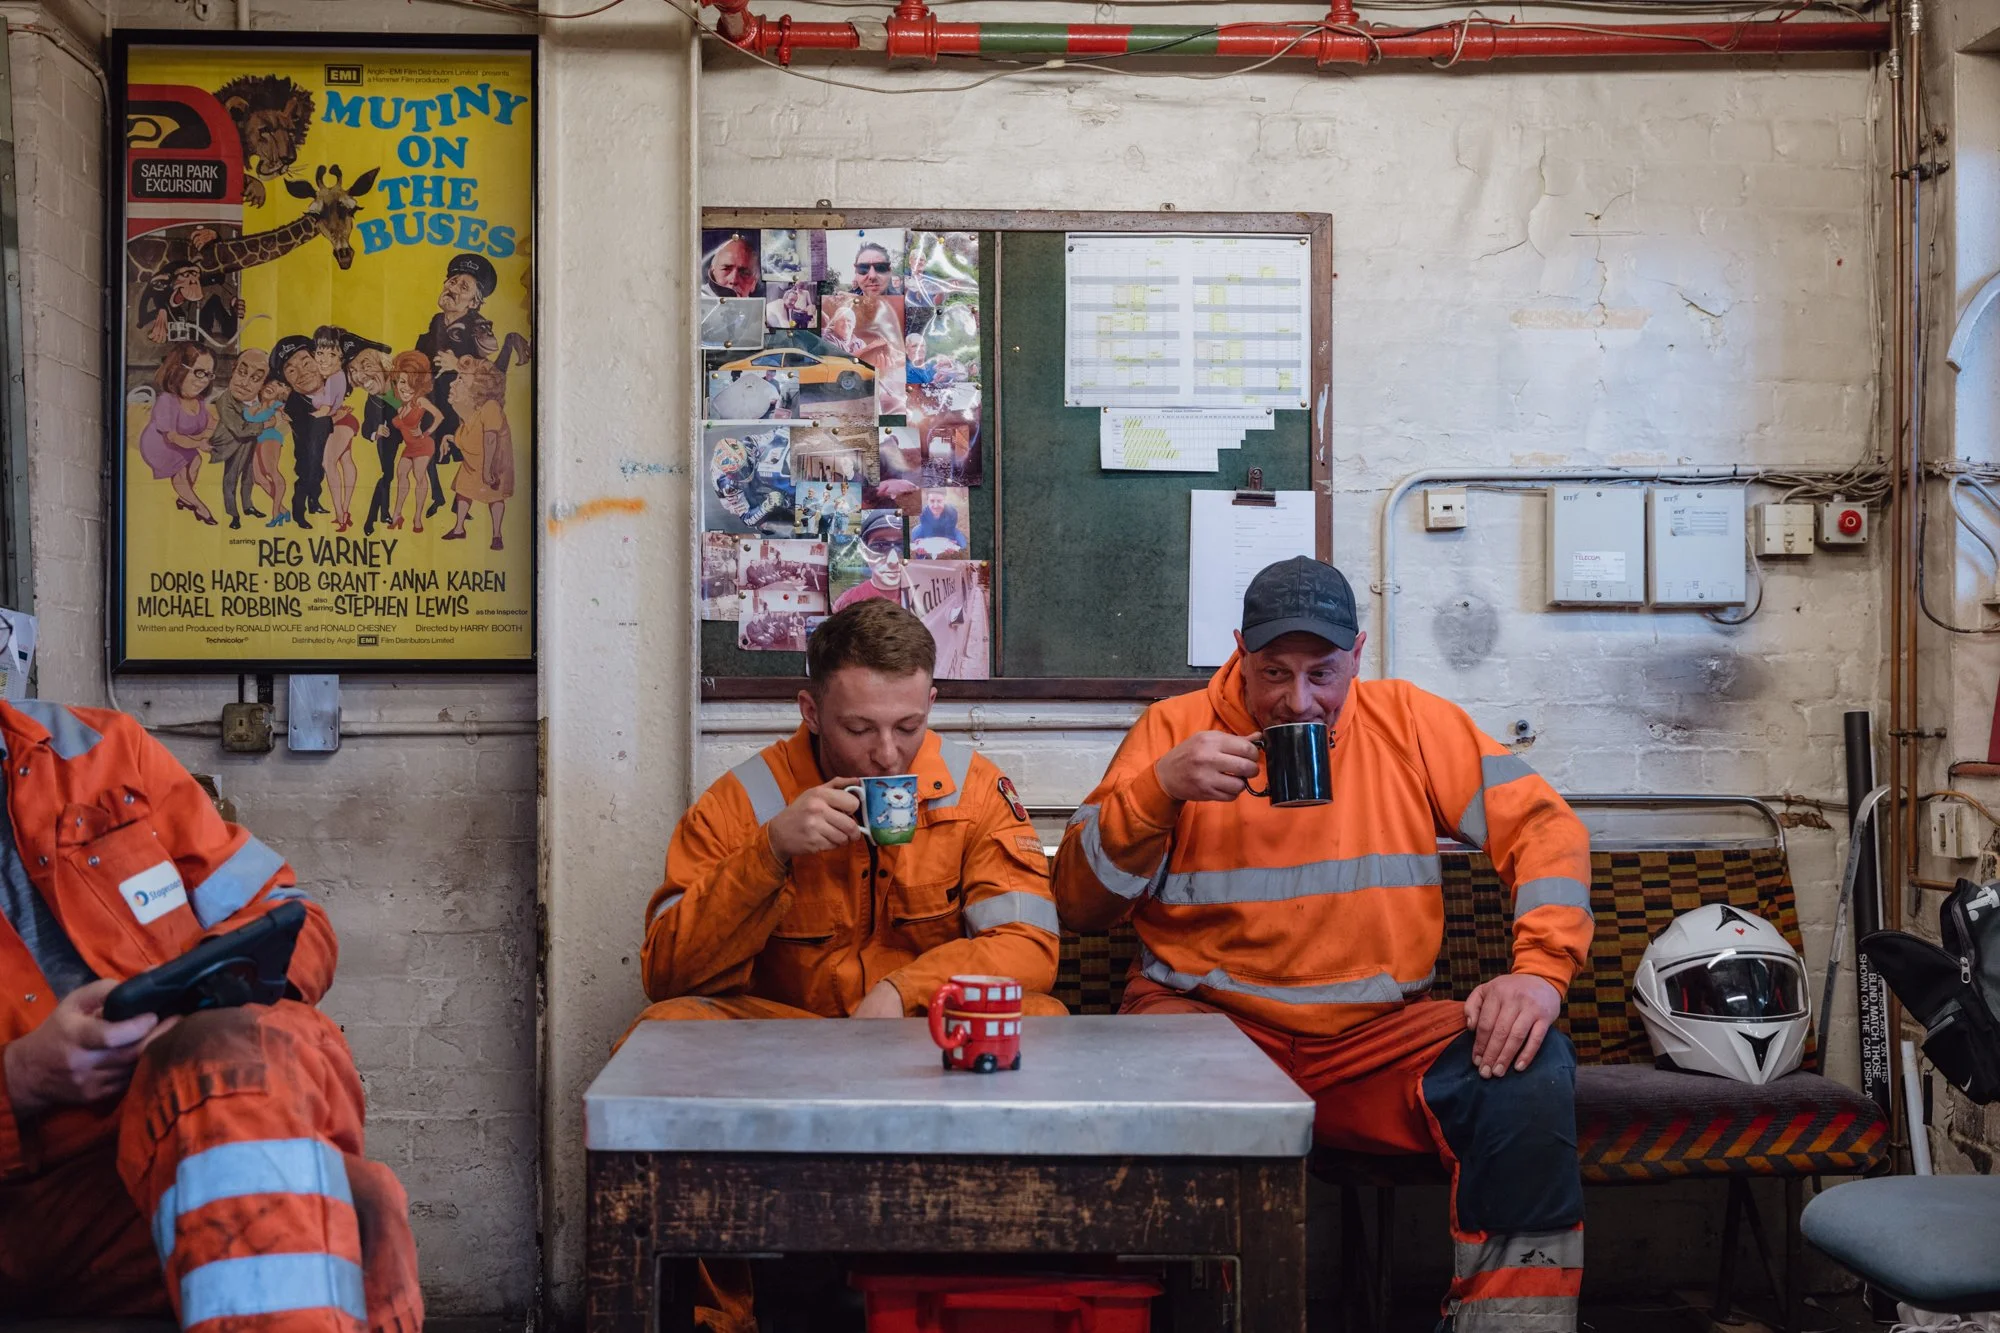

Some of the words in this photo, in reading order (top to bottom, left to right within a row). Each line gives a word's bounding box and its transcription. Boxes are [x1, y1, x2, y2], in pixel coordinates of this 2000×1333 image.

[330, 69, 358, 81] EMI
[321, 83, 529, 133] MUTINY
[398, 135, 469, 169] ON
[141, 164, 183, 178] SAFARI
[187, 165, 218, 179] PARK
[146, 179, 212, 193] EXCURSION
[378, 175, 479, 212] THE
[357, 212, 516, 259] BUSES
[229, 538, 256, 546] starring
[258, 537, 304, 568] REG
[308, 536, 398, 568] VARNEY
[151, 571, 206, 594] DORIS
[212, 570, 259, 593] HARE
[274, 571, 311, 592] BOB
[318, 571, 380, 593] GRANT
[390, 569, 439, 593] ANNA
[448, 570, 506, 592] KAREN
[138, 595, 214, 618] MICHAEL
[222, 595, 303, 618] ROBBINS
[308, 605, 333, 613] starring
[335, 594, 408, 618] STEPHEN
[416, 595, 469, 617] LEWIS
[225, 625, 235, 633] by
[450, 625, 459, 633] by
[337, 637, 355, 645] Anglo
[1859, 953, 1868, 992] SHOWN
[1868, 973, 1878, 1002] BLIND
[1861, 995, 1869, 1010] ON
[1862, 1014, 1870, 1033] THE
[1870, 1005, 1879, 1041] MATCH
[1863, 1037, 1871, 1058] CAB
[1872, 1044, 1881, 1079] THOSE
